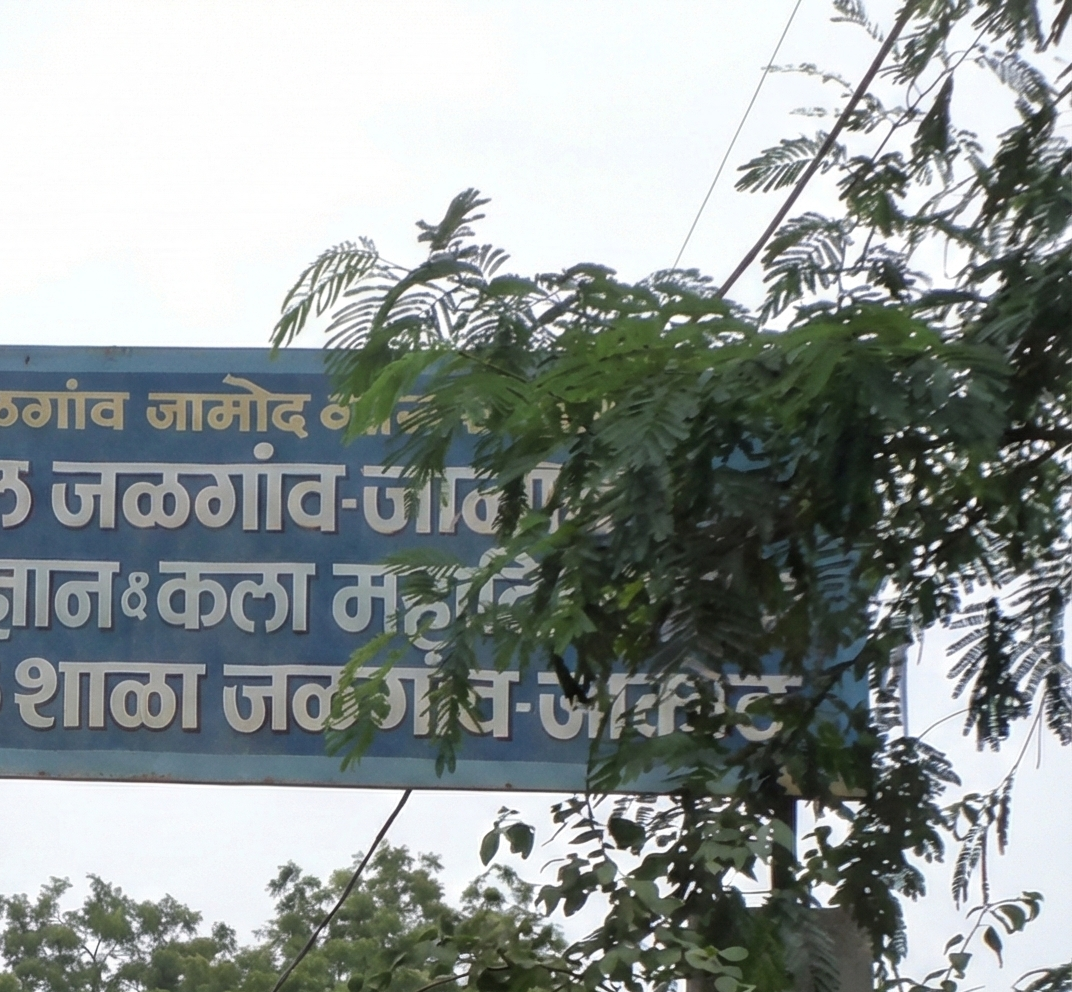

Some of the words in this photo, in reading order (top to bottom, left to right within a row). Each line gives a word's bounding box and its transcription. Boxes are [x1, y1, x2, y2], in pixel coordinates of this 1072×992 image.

[145, 373, 312, 439] जामोद
[156, 561, 316, 635] कला
[14, 656, 207, 732] शाळा
